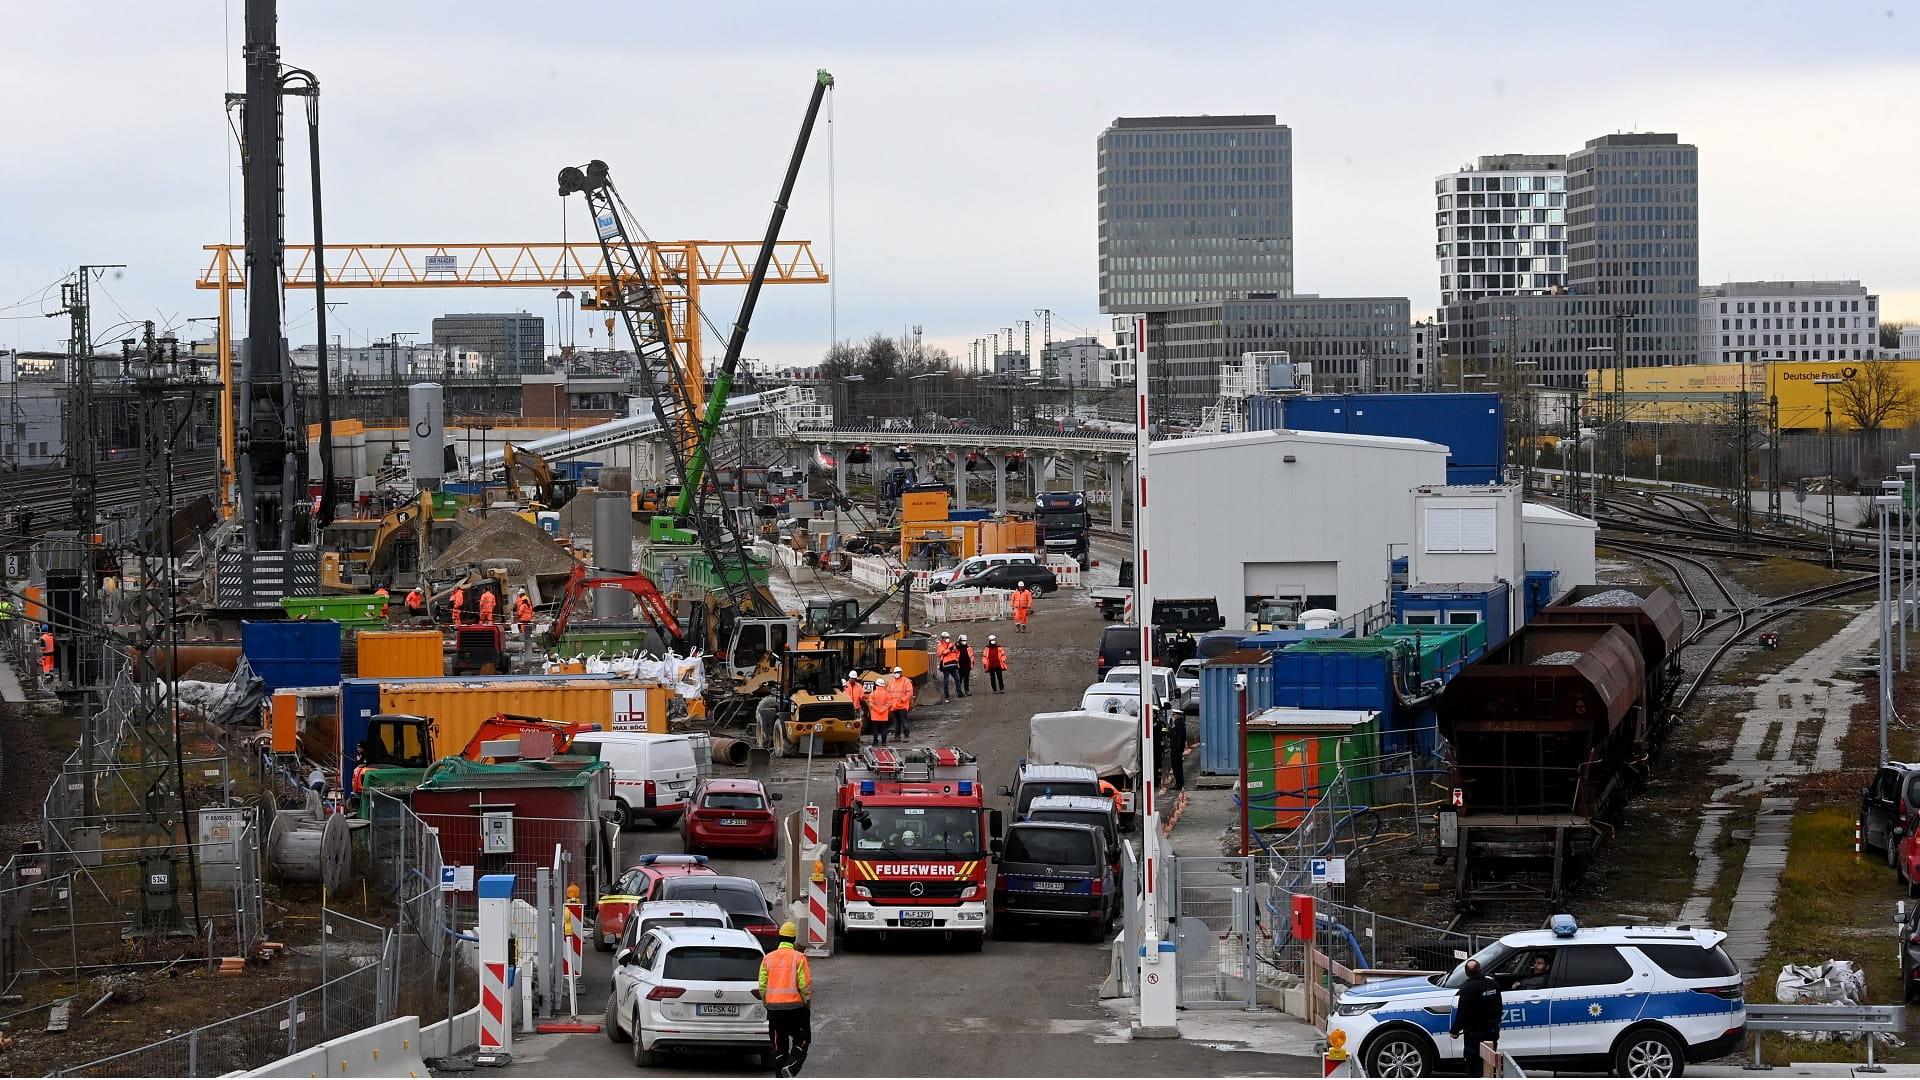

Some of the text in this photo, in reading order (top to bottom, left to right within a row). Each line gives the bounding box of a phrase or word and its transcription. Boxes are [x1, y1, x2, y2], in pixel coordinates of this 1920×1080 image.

[1783, 372, 1840, 381] Deutsche Post
[876, 864, 956, 876] FEUERWEHR
[703, 1004, 737, 1013] VG SK 40
